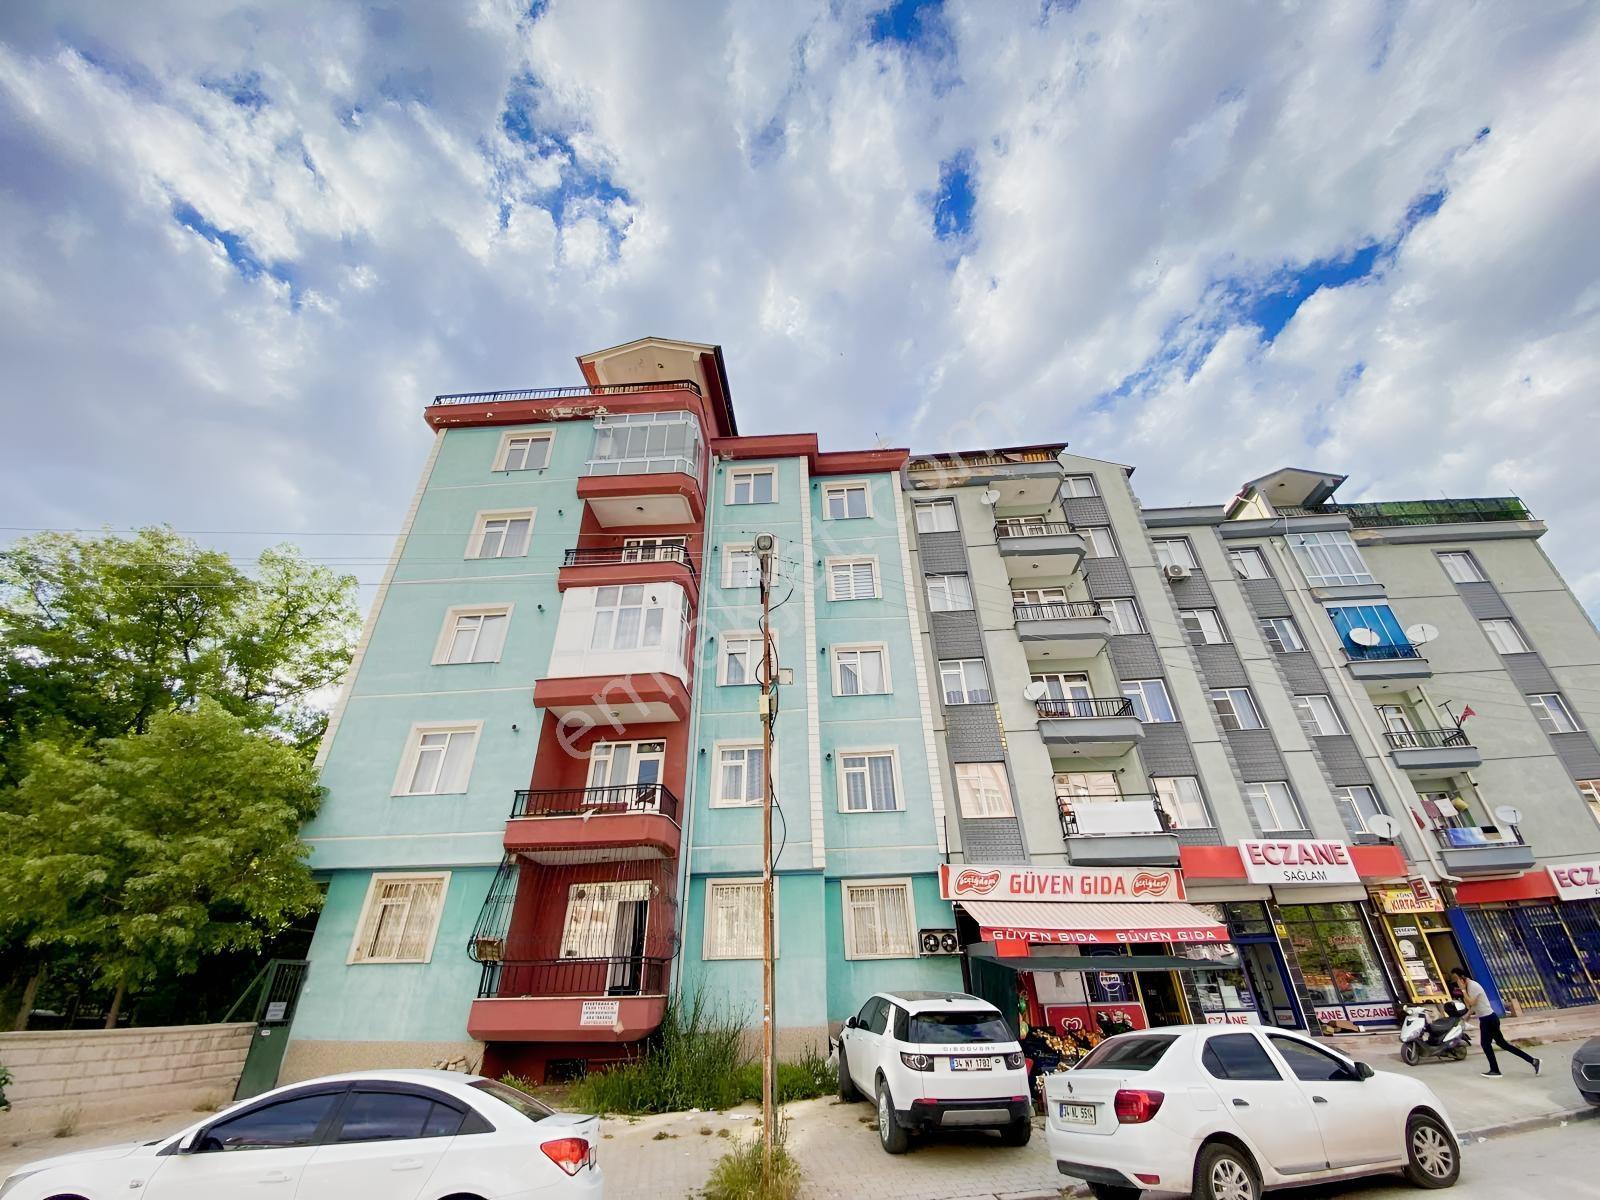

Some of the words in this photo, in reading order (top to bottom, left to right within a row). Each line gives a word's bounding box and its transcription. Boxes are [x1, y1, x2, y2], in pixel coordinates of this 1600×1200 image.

[1246, 843, 1349, 865] ECZANE
[1009, 871, 1074, 895] GÜVEN
[1080, 875, 1127, 895] GIDA
[1283, 869, 1328, 881] SAĞLAM
[1553, 867, 1600, 887] ECZ
[1412, 880, 1429, 897] E
[992, 929, 1052, 942] GÜVEN
[1058, 932, 1100, 942] GIDA
[1115, 930, 1172, 942] GÜVEN
[1177, 930, 1217, 941] GIDA
[1350, 1007, 1395, 1018] ECZANE
